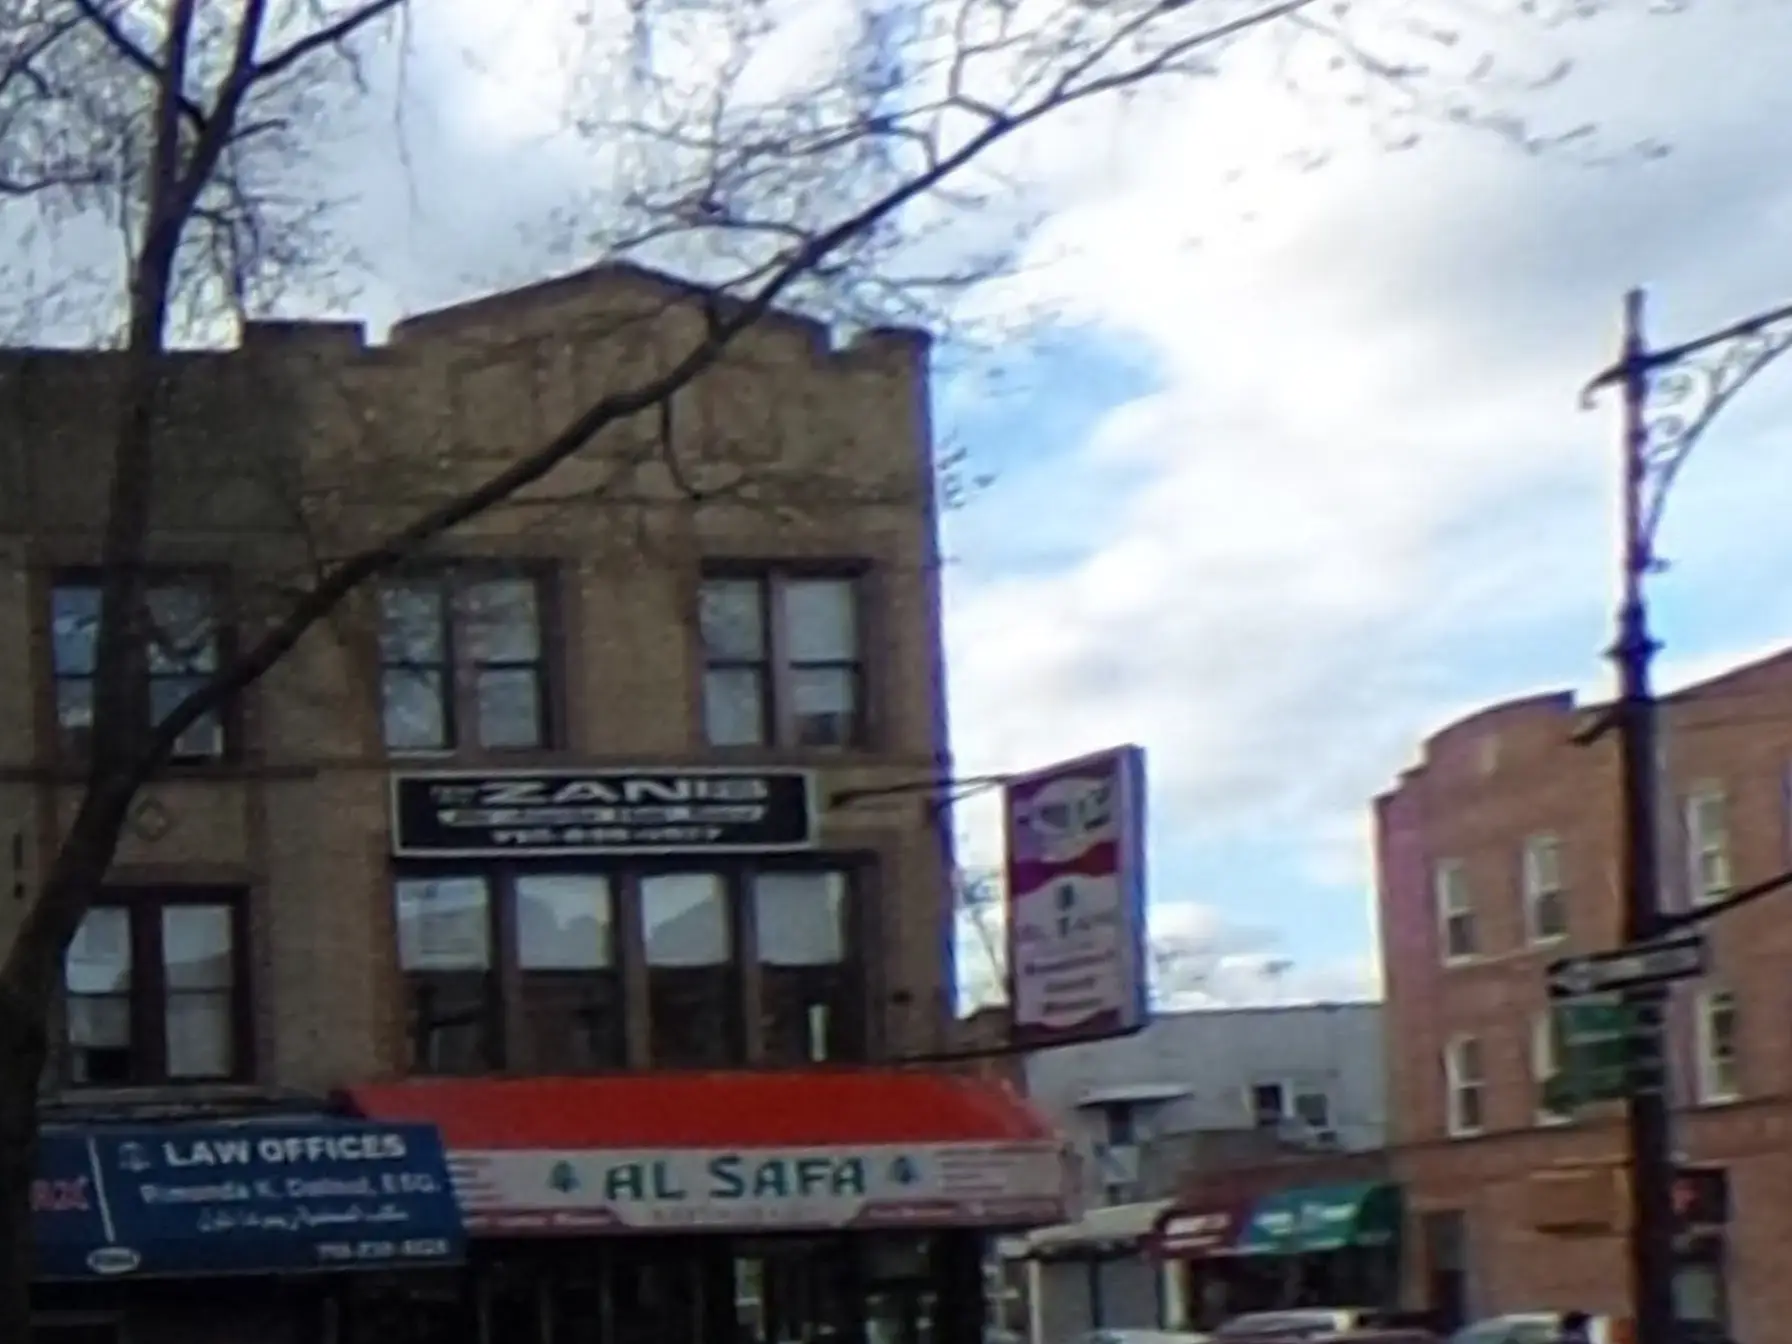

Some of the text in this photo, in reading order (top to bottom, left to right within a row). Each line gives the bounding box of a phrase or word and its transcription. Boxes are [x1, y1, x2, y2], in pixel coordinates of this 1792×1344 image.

[162, 1134, 406, 1168] LAW OFFICES
[604, 1156, 865, 1201] AL SAFA
